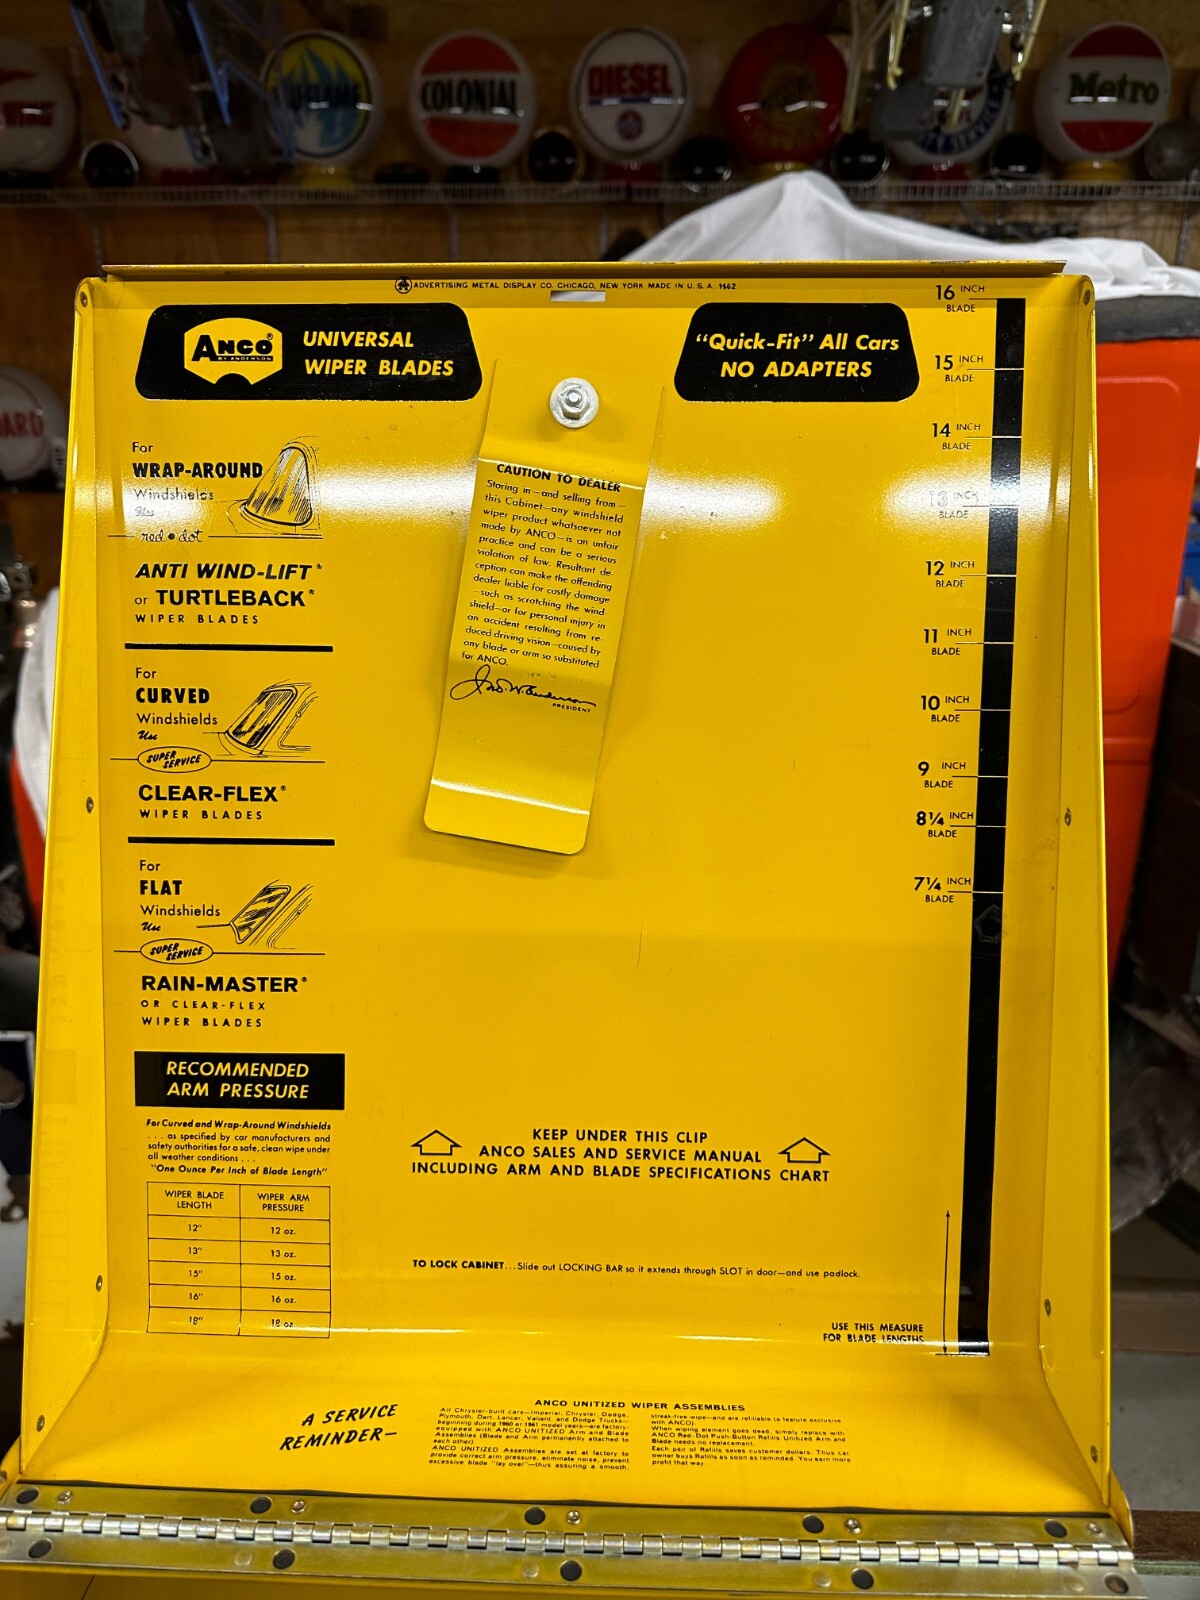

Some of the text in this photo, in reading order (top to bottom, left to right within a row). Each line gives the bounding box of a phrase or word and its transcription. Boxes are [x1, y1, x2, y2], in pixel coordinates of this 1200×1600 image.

[588, 63, 671, 97] DIESEL
[1069, 72, 1159, 106] Metro
[420, 80, 520, 114] COLONIAL
[557, 282, 597, 290] CHICAGO,
[936, 285, 985, 300] 16 INCH
[946, 304, 975, 312] BLADE
[303, 331, 414, 347] UNIVERSAL
[819, 334, 847, 350] All
[856, 335, 899, 350] Cars
[305, 359, 454, 376] WIPER BLADES
[934, 354, 984, 370] 15 INCH
[721, 362, 872, 377] NO ADAPTERS
[945, 374, 974, 382] BLADE
[132, 442, 153, 452] For
[133, 463, 263, 478] WRAP-AROUND
[497, 464, 621, 493] CAUTION TO DEALER
[134, 487, 214, 500] Windshields
[483, 508, 621, 537] wiper product whatsoever not
[140, 529, 203, 542] red dot
[135, 564, 188, 578] ANTI
[925, 560, 975, 576] 12 INCH
[135, 596, 148, 605] or
[136, 614, 258, 624] WIPER BLADES
[461, 651, 508, 666] for ANCO.
[135, 667, 157, 679] For
[136, 688, 210, 703] CURVED
[552, 702, 591, 713] PRESIDENT
[921, 695, 969, 710] 10 INCH
[137, 713, 217, 725] Windshields
[931, 714, 960, 722] BLADE
[138, 731, 157, 740] Use
[146, 751, 177, 763] SUPER
[163, 754, 201, 768] SERVICE
[917, 761, 966, 776] 9 INCH
[924, 780, 953, 789] BLADE
[140, 810, 262, 819] WIPER BLADES
[140, 860, 160, 871] For
[140, 880, 182, 895] FLAT
[947, 877, 971, 886] INCH
[925, 895, 954, 903] BLADE
[140, 905, 220, 916] Windshields
[141, 922, 161, 931] Use
[150, 943, 179, 955] SUPER
[166, 947, 204, 961] SERVICE
[141, 1000, 265, 1010] OR CLEAR-FLEX
[142, 1017, 262, 1027] WIPER BLADES
[166, 1061, 309, 1078] RECOMMENDED
[167, 1082, 309, 1099] ARM PRESSURE
[146, 1119, 331, 1130] For Curved and Wrap-Around Windshields
[533, 1128, 708, 1143] KEEP UNDER THIS CLIP
[479, 1145, 761, 1163] ANCO SALES AND SERVICE MANUAL
[179, 1165, 206, 1174] Ounce
[228, 1166, 246, 1175] Inch
[250, 1166, 260, 1175] of
[263, 1167, 288, 1176] Blade
[412, 1162, 829, 1182] INCLUDING ARM AND BLADE SPECIFICATIONS CHART
[165, 1190, 224, 1200] WIPER BLADE
[257, 1193, 310, 1201] WIPER ARM
[177, 1201, 212, 1209] LENGTH
[262, 1203, 304, 1212] PRESSURE
[413, 1260, 860, 1278] TO LOCK LOCKING BAR SLOT padlock.
[271, 1295, 281, 1303] 16
[855, 1323, 874, 1331] THIS
[880, 1323, 924, 1332] MEASURE
[823, 1333, 924, 1343] FOR BLADE LENGTHS
[301, 1404, 398, 1426] A SERVICE
[436, 1425, 472, 1433] equipped
